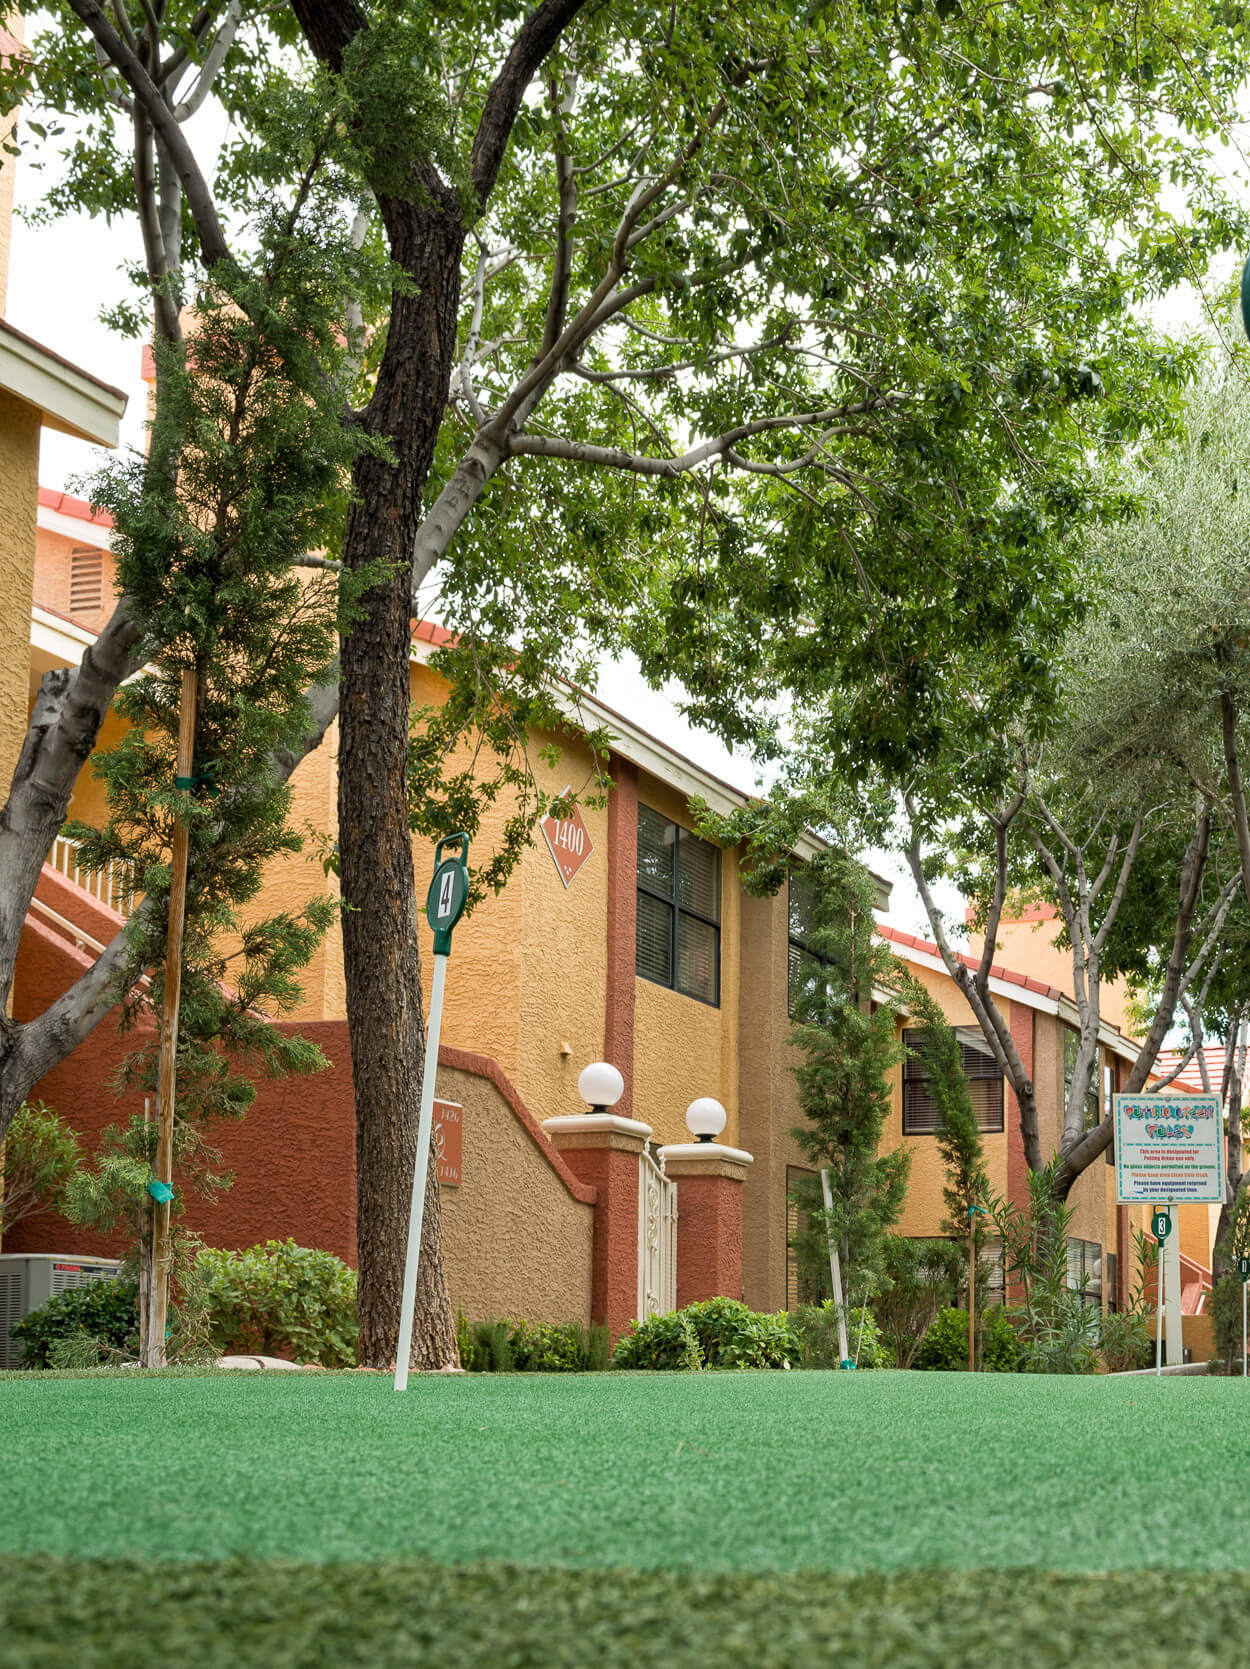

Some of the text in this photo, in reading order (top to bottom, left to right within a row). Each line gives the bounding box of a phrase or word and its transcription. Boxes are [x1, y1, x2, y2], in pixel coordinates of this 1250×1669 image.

[554, 819, 584, 856] 1400
[441, 874, 451, 913] 4
[1160, 1218, 1165, 1233] 3
